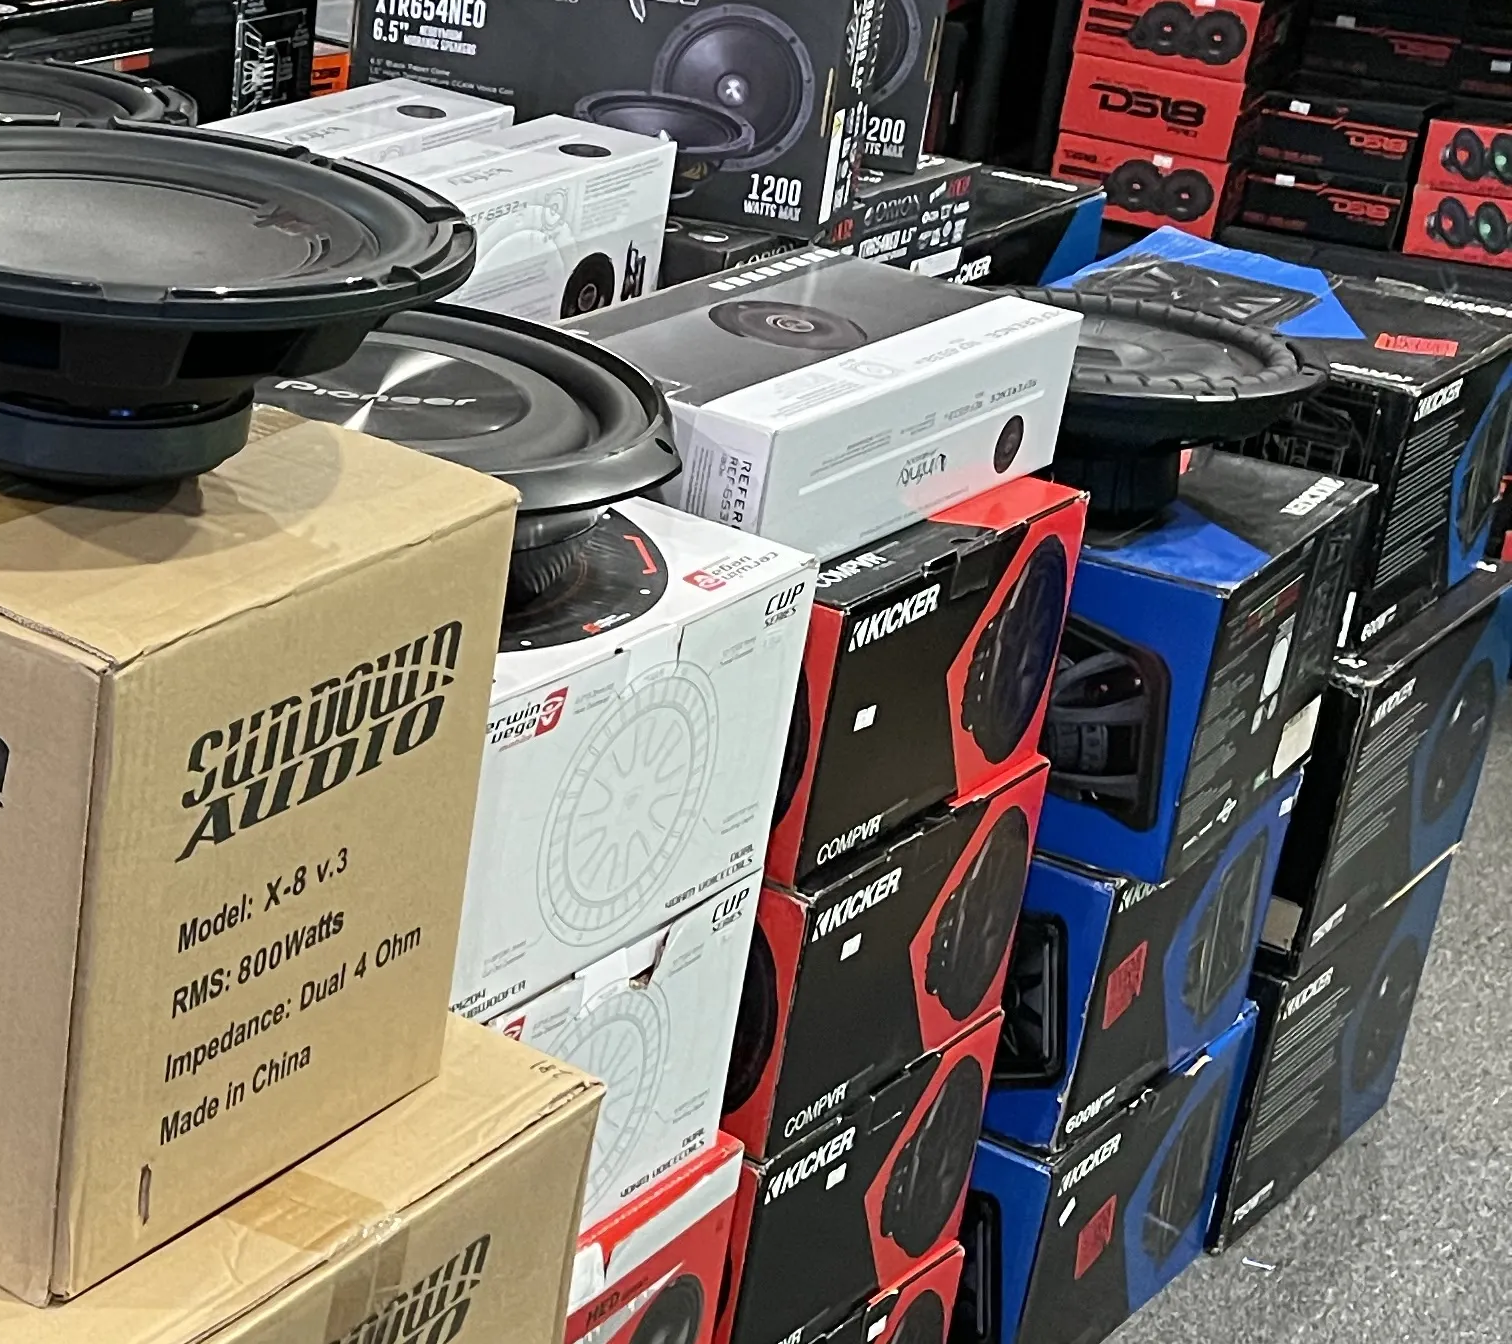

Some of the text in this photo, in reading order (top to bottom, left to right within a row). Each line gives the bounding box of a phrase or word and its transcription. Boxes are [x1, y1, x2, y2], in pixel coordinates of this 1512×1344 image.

[1088, 83, 1206, 128] DS18
[748, 173, 802, 205] 1200
[778, 203, 802, 222] MAX
[275, 380, 477, 406] Pioneer
[731, 460, 753, 529] REFER
[764, 581, 806, 617] CUP
[856, 583, 941, 648] KICKER
[182, 620, 462, 808] SUNDOWN
[176, 695, 446, 864] AUDIO
[816, 814, 883, 867] COMPVR
[177, 848, 348, 954] Model: X-8 v.3
[712, 887, 750, 923] CUP
[820, 866, 902, 940] KICKER
[172, 908, 344, 1020] RMS: 800Watts
[164, 925, 422, 1082] Impedance: Dual 4 Ohm
[462, 980, 527, 1018] UBWOOFER
[160, 1044, 312, 1146] Made in China
[784, 1080, 849, 1140] COMPVR
[770, 1126, 856, 1202] KICKER
